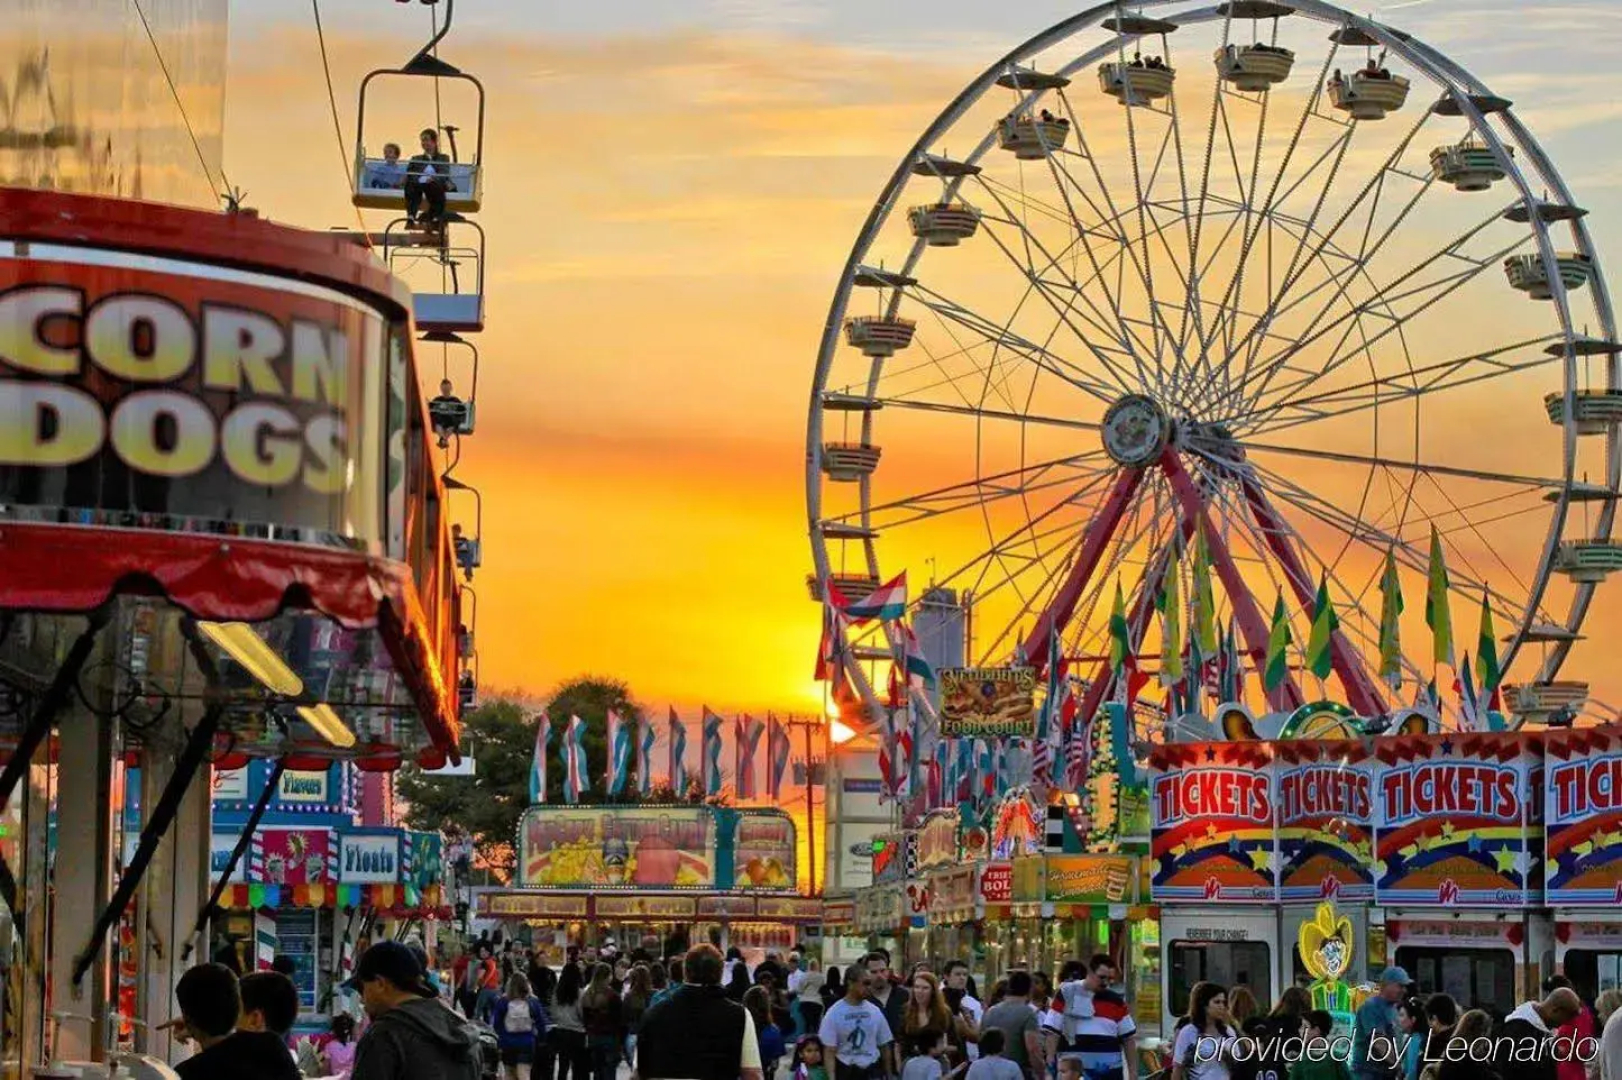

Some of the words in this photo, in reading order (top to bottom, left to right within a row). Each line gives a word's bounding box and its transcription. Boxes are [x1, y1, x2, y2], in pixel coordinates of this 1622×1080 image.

[0, 282, 347, 401] CORN
[0, 382, 347, 494] DOGS
[942, 719, 981, 735] FOOD
[984, 719, 1031, 735] COURT
[1156, 770, 1272, 823] TICKETS
[1281, 768, 1372, 822] TICKETS
[1383, 765, 1518, 819] TICKETS
[345, 844, 393, 873] Floats
